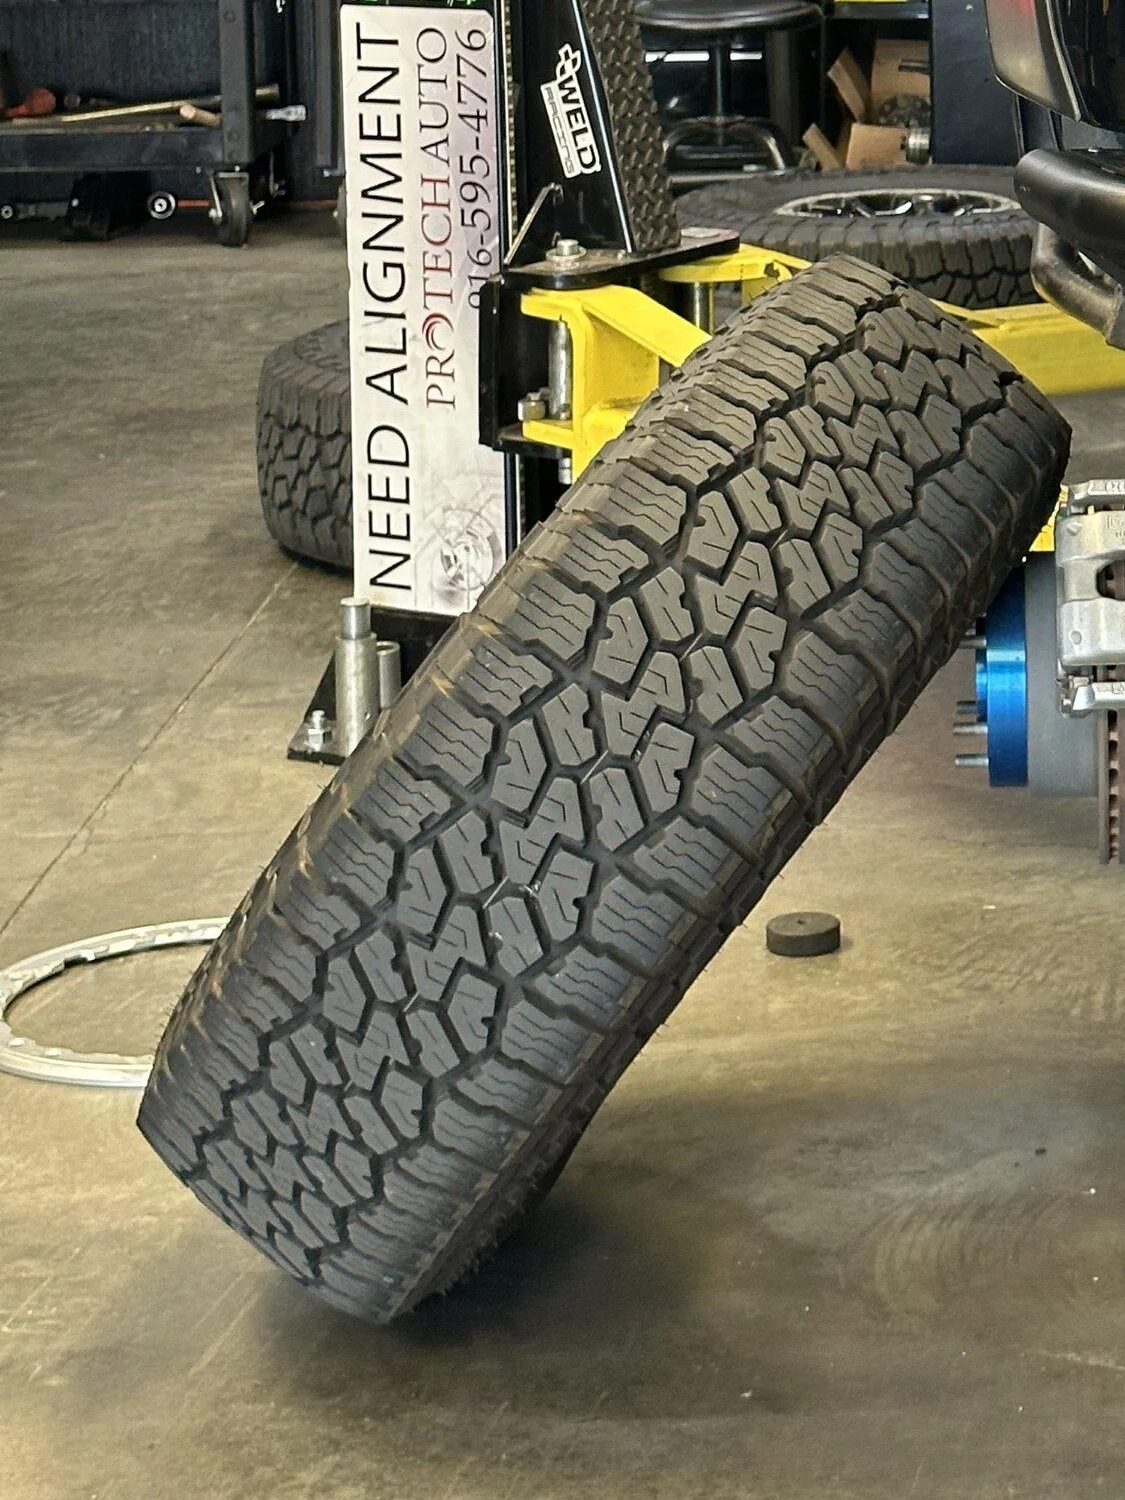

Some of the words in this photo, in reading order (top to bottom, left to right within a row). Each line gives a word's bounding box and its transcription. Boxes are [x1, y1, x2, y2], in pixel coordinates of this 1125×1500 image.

[557, 75, 597, 169] WELD
[356, 22, 409, 405] ALIGNMENT
[366, 424, 412, 591] NEED
